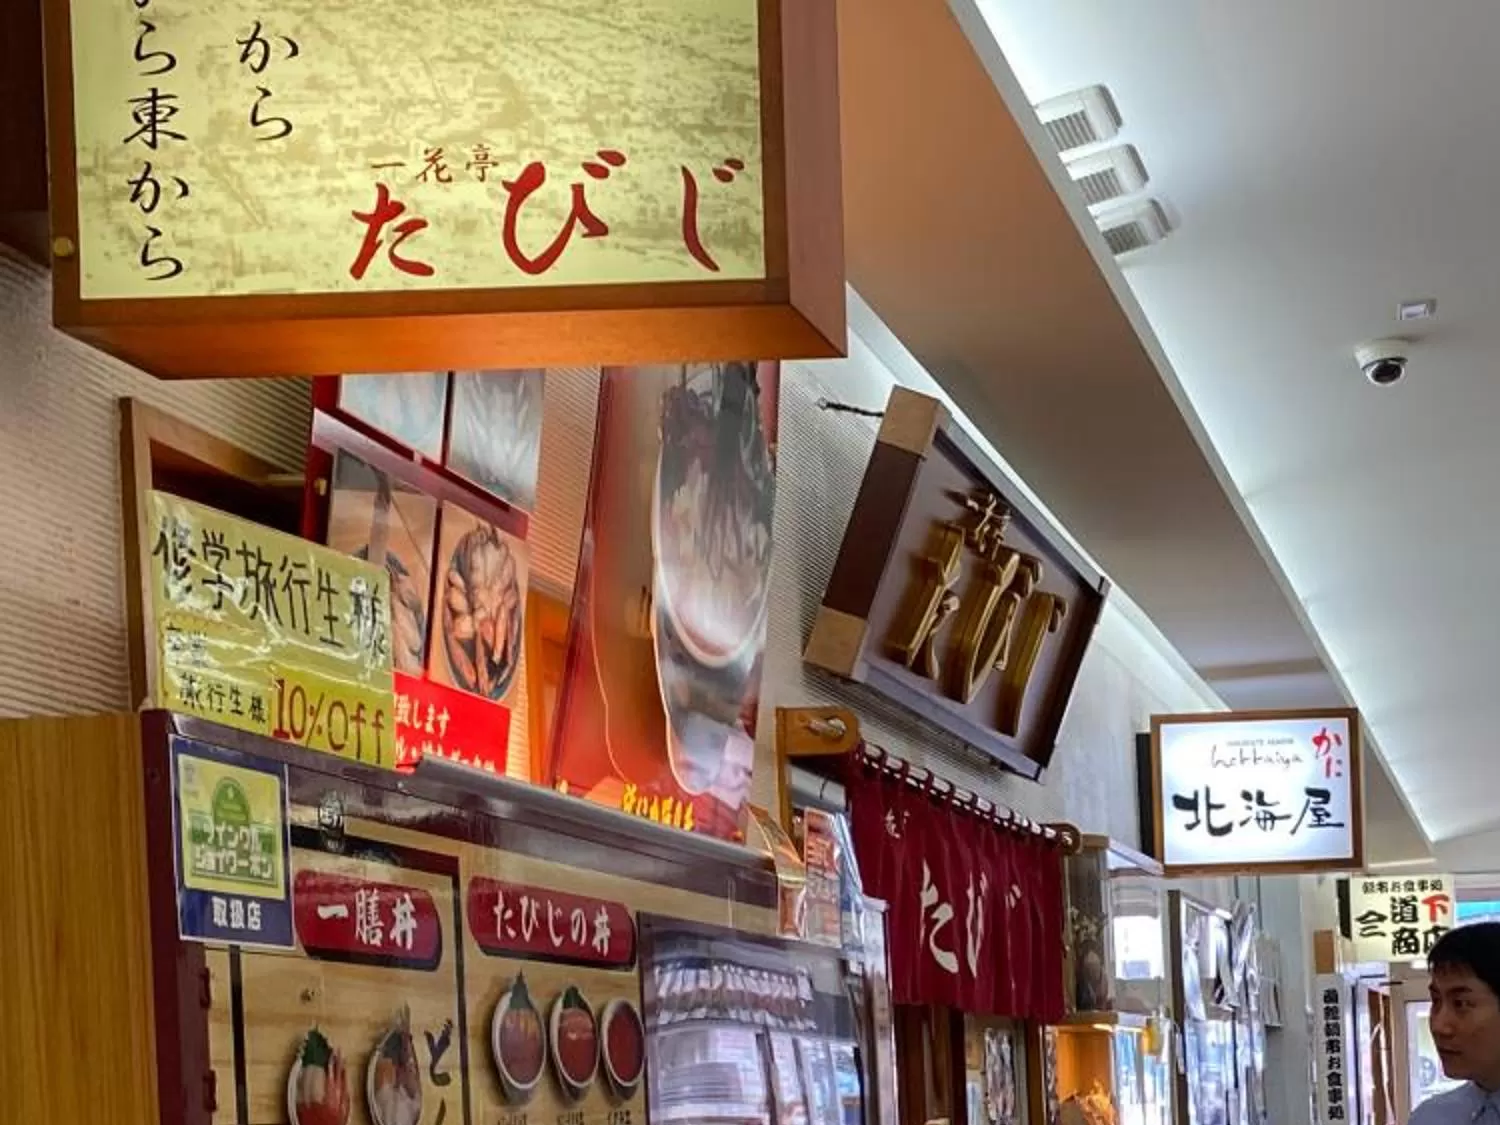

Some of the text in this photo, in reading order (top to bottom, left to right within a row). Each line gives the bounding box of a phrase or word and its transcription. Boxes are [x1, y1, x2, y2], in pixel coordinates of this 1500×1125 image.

[236, 20, 299, 141] から
[123, 0, 189, 282] ら東から
[370, 142, 500, 185] 一花亭
[350, 149, 746, 280] たびじ
[1313, 728, 1342, 778] かに
[1172, 785, 1344, 837] 北海屋
[493, 890, 612, 957] たびじの丼
